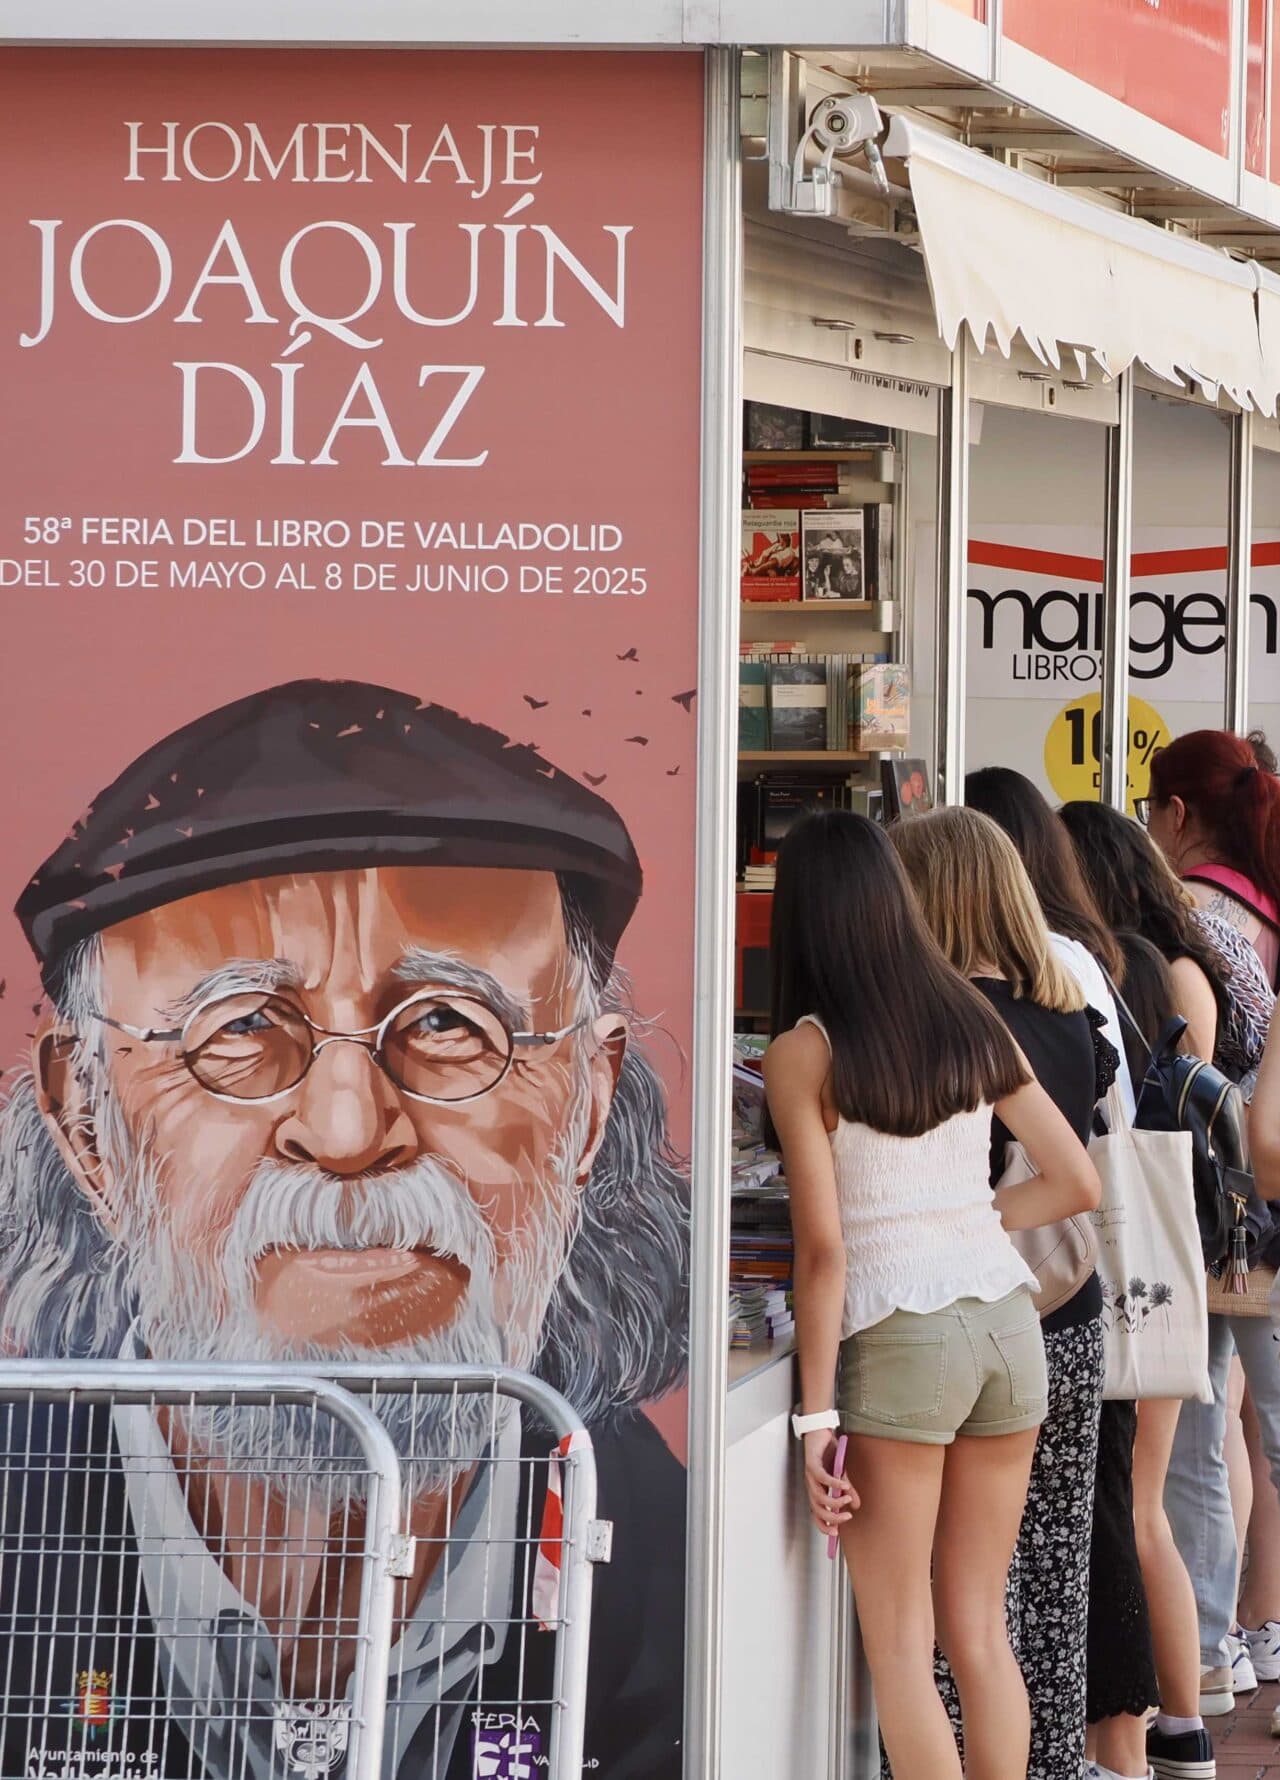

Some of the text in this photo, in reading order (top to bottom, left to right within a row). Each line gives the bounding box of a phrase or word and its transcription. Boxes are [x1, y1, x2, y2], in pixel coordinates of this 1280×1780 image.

[123, 122, 543, 199] HOMENAJE
[19, 192, 634, 350] JOAQUÍN
[172, 331, 489, 466] DÍAZ
[23, 516, 623, 552] 58ª FERIA DEL LIBRO DE VALLADOLID
[0, 559, 648, 595] DEL 30 DE MAYO AL 8 DE JUNIO DE 2025
